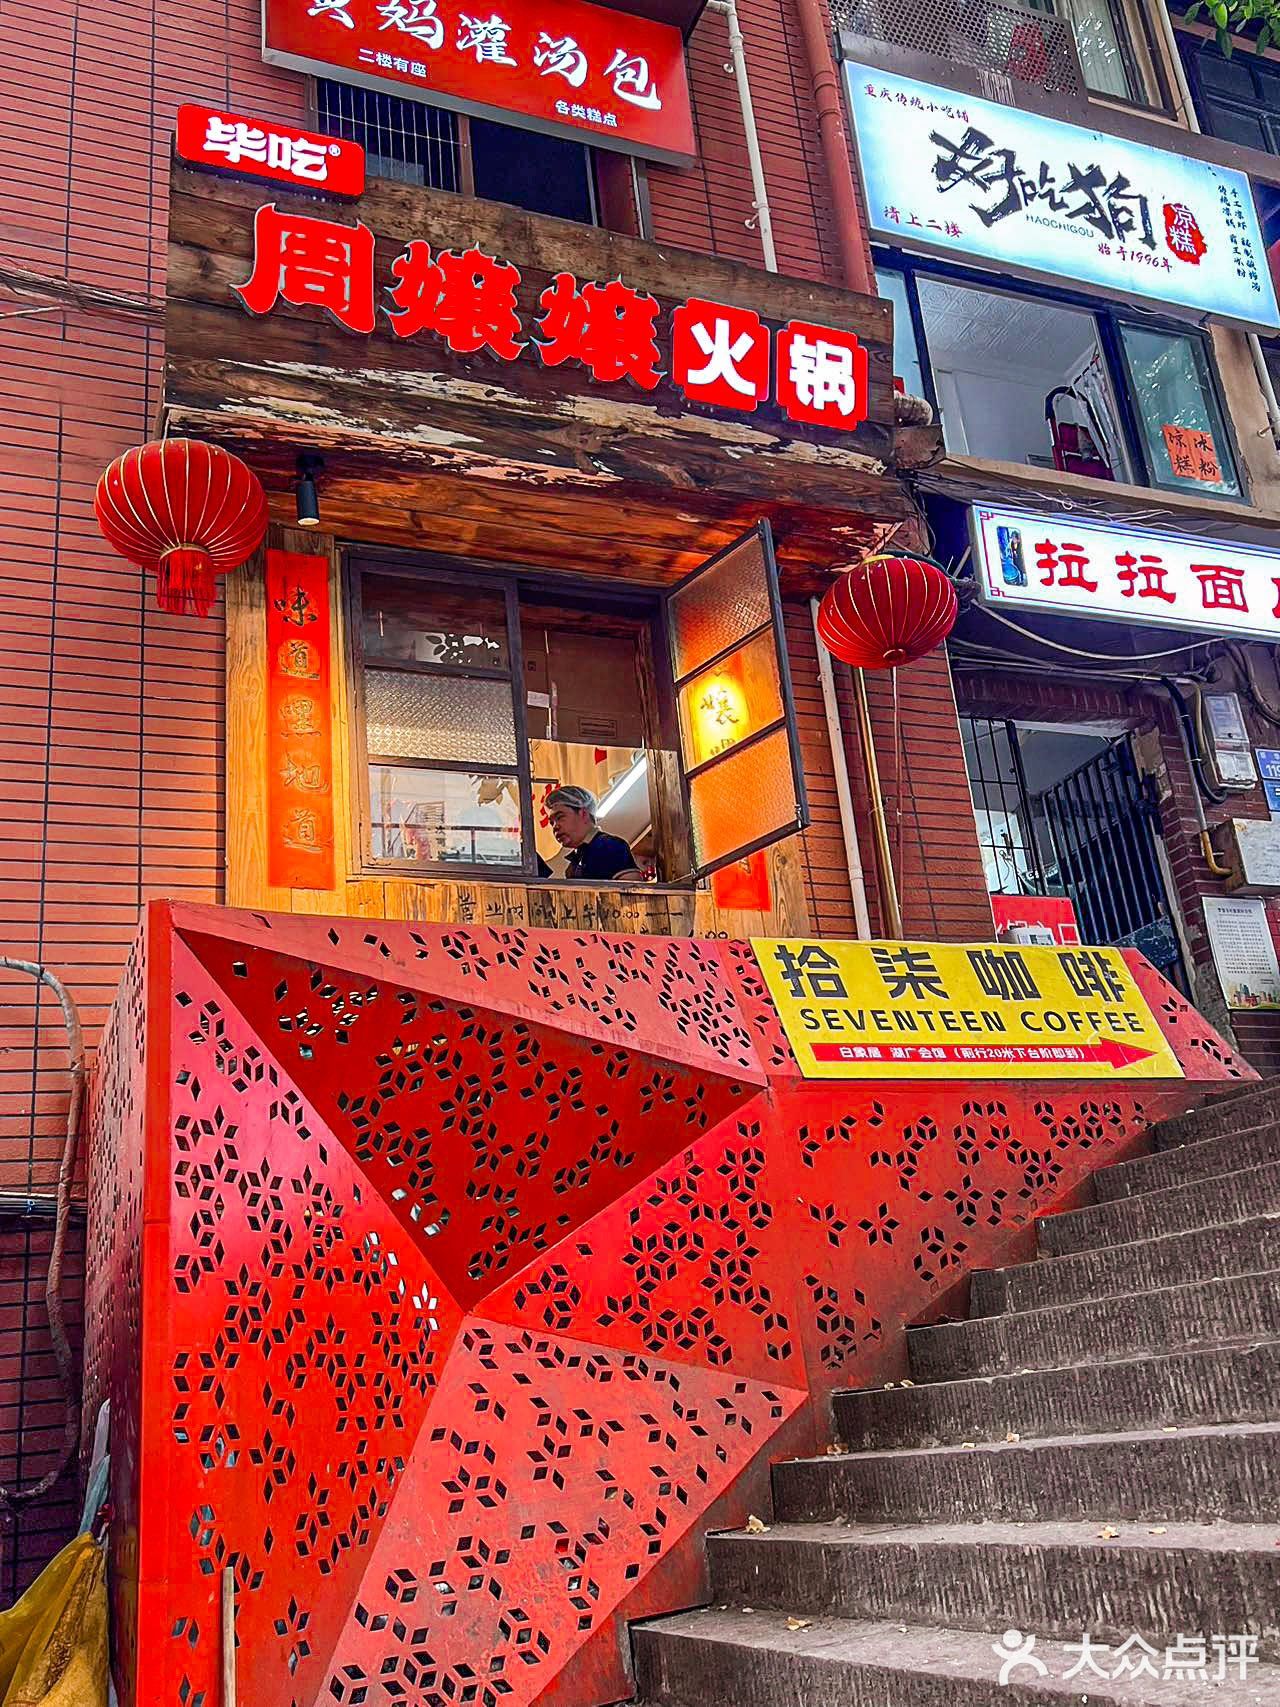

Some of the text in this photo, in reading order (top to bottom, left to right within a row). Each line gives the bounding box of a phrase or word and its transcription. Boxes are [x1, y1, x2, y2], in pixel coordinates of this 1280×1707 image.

[358, 48, 427, 78] 二楼有座
[555, 99, 618, 127] 各类糕点
[863, 83, 969, 123] 重庆传统小吃铺
[883, 205, 963, 239] 请上二楼
[1025, 213, 1095, 239] HAOCHIGOU
[1169, 203, 1198, 255] 凉糕
[1097, 243, 1173, 273] 始于1996年
[1034, 538, 1280, 619] 拉拉面
[776, 944, 1126, 1003] 拾柒咖啡
[799, 1007, 1146, 1033] SEVENTEEN COFFEE
[839, 1046, 882, 1059] 白象居
[890, 1046, 948, 1060] 湖广会馆
